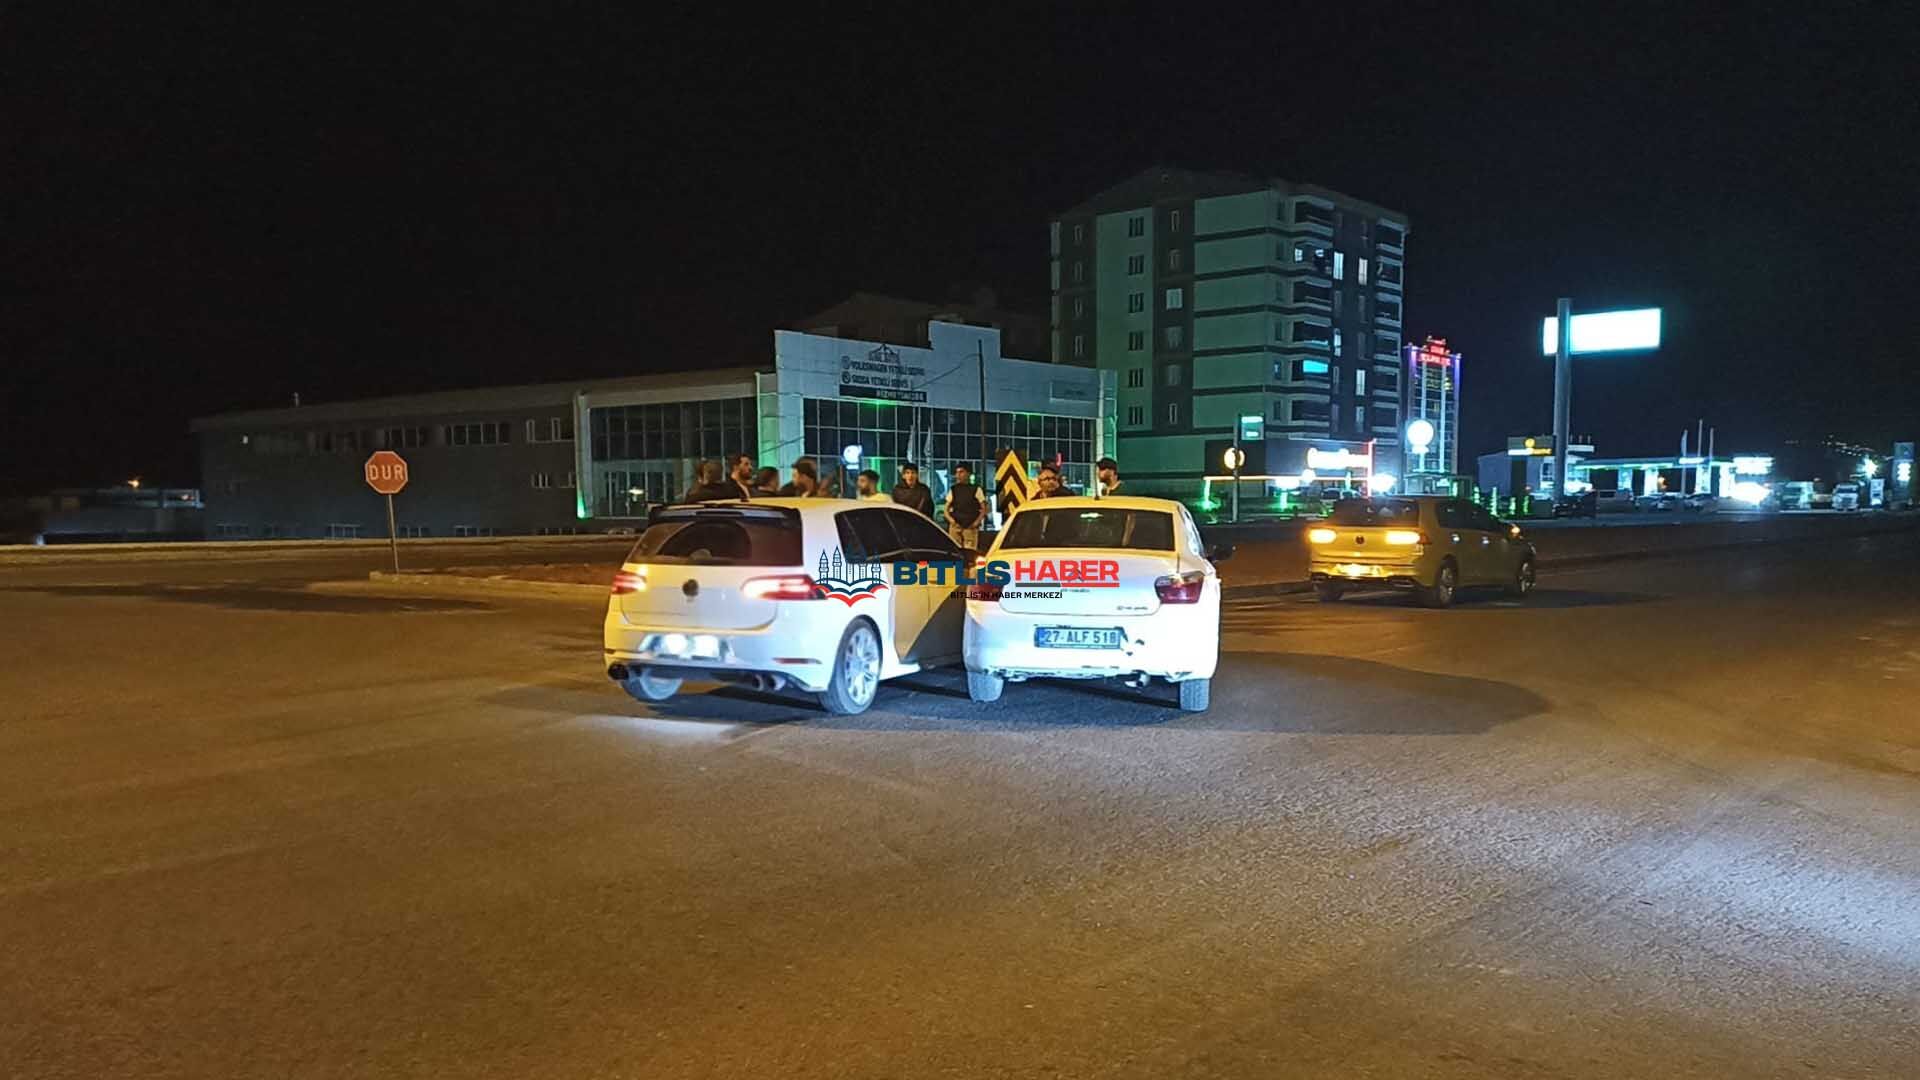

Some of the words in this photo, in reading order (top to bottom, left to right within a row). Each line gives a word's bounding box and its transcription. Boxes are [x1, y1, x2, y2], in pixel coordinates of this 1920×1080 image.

[369, 464, 404, 481] DUR
[1045, 630, 1060, 643] 27
[1066, 631, 1090, 643] ALF
